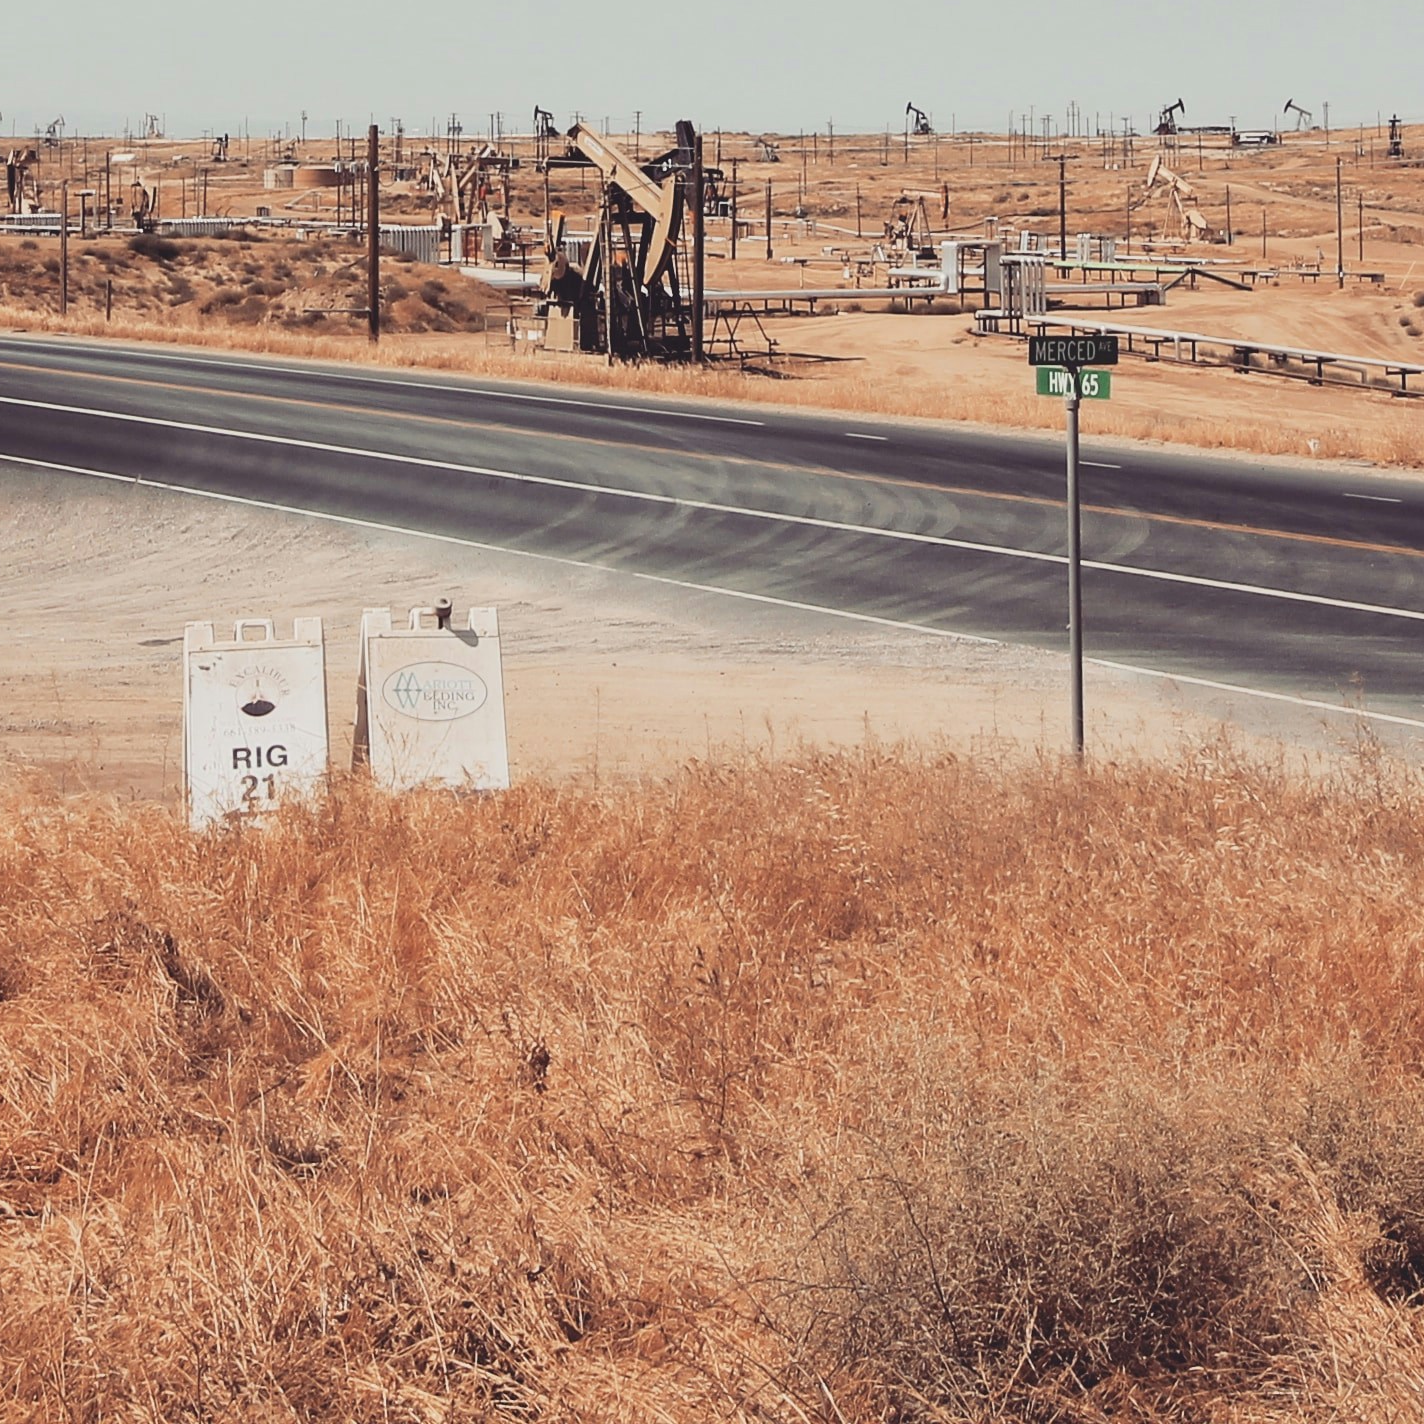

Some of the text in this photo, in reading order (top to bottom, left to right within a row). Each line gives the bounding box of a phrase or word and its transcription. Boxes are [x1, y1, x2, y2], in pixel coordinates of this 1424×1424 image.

[1035, 341, 1112, 362] MERCED AVE
[1049, 371, 1099, 396] HWY 65
[228, 665, 290, 696] EXCALIBUR
[232, 744, 288, 770] RIG
[241, 773, 275, 802] 21
